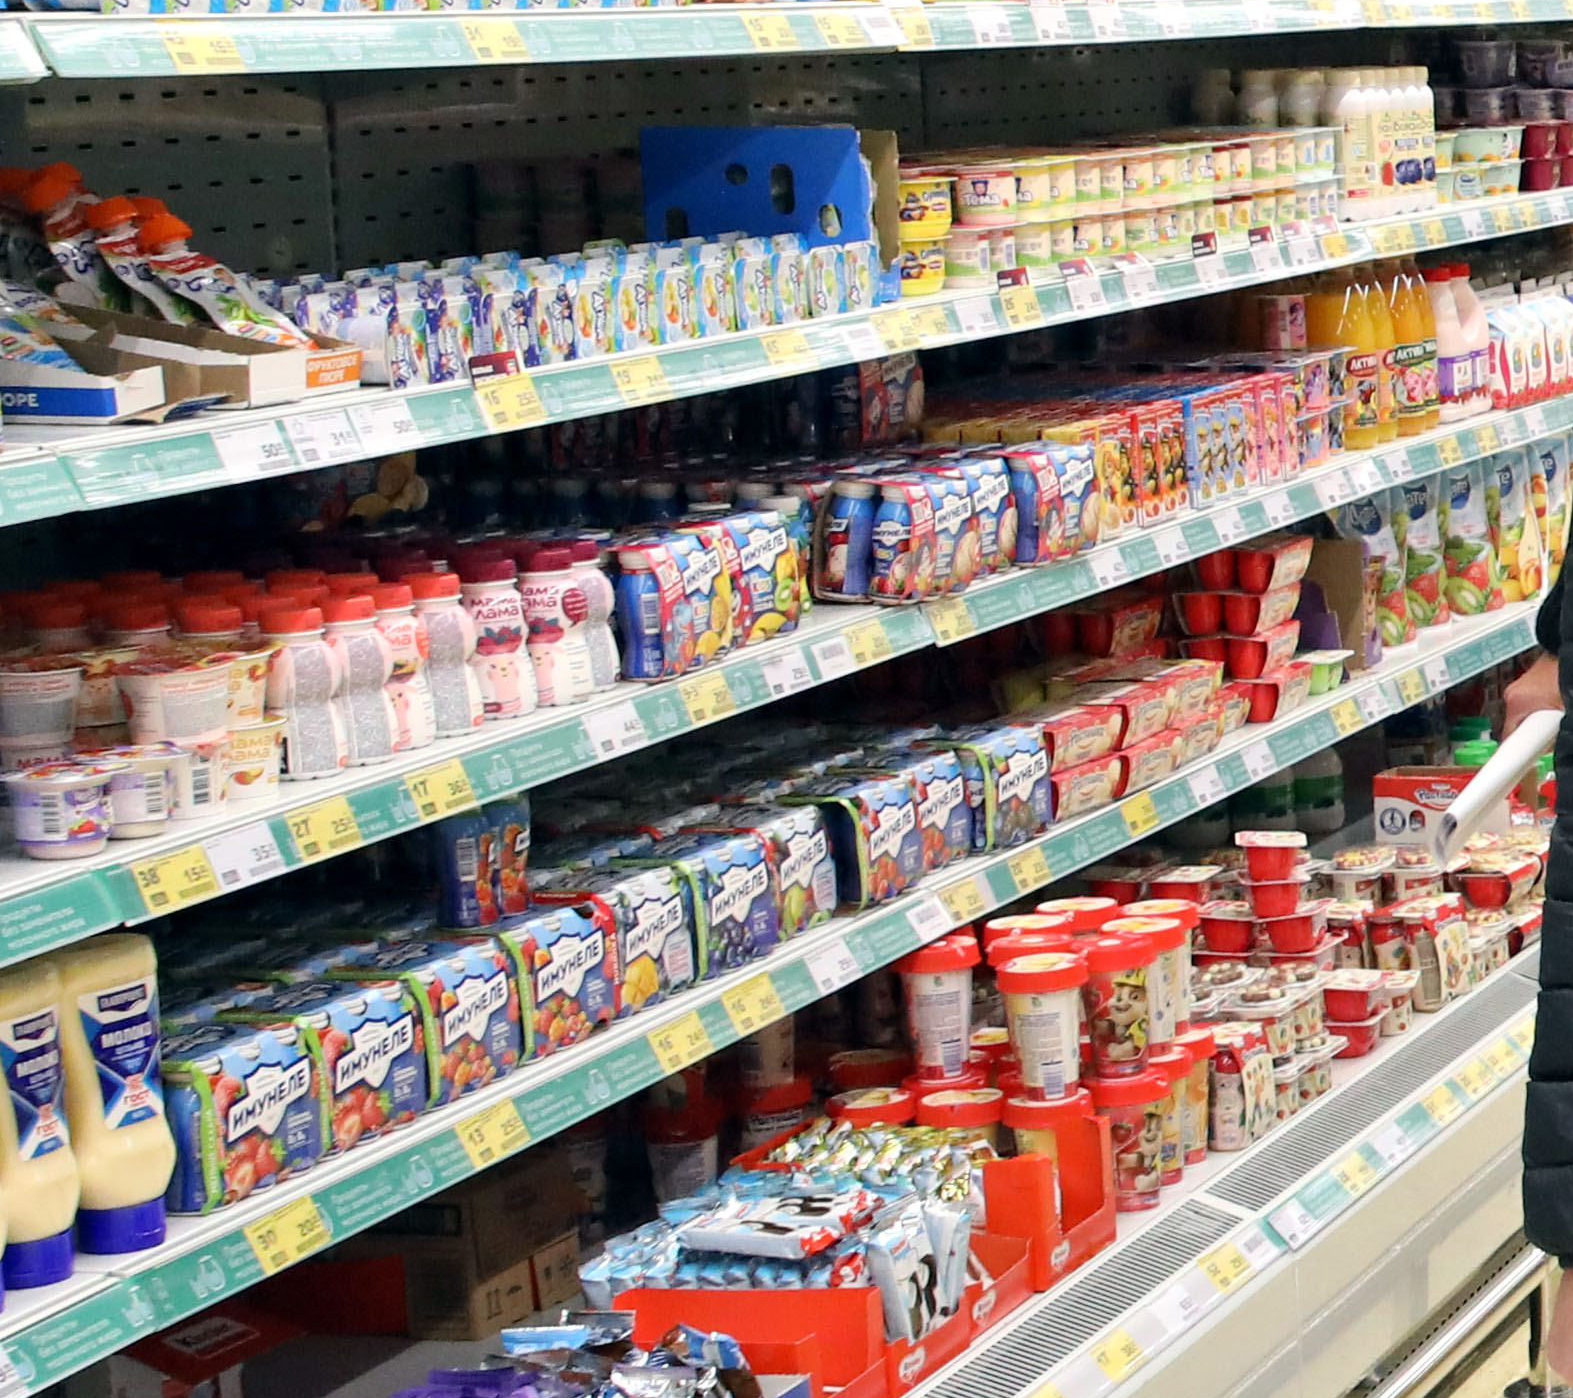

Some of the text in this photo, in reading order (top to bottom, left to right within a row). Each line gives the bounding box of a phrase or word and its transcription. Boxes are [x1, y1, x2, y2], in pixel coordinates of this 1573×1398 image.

[307, 354, 358, 373] ФРУКТОВОЕ
[319, 369, 345, 384] ПЮРЕ
[743, 532, 786, 564] ИМУНЕЛЕ
[1000, 759, 1046, 794] ИМУНЕЛЕ
[920, 781, 965, 821] ИМУНЕЛЕ
[871, 812, 916, 851] ИМУНЕЛЕ
[781, 836, 827, 882] ИМУНЕЛЕ
[714, 868, 767, 917] ИМУНЕЛЕ
[627, 905, 681, 957] ИМУНЕЛЕ
[540, 936, 601, 990] ИМУНЕЛЕ
[447, 978, 506, 1034] ИМУНЕЛЕ
[101, 1021, 152, 1049] МОЛОКО
[339, 1025, 410, 1080] ИМУНЕЛЕ
[123, 1090, 149, 1105] ГОСТ
[232, 1067, 308, 1128] ИМУНЕЛЕ
